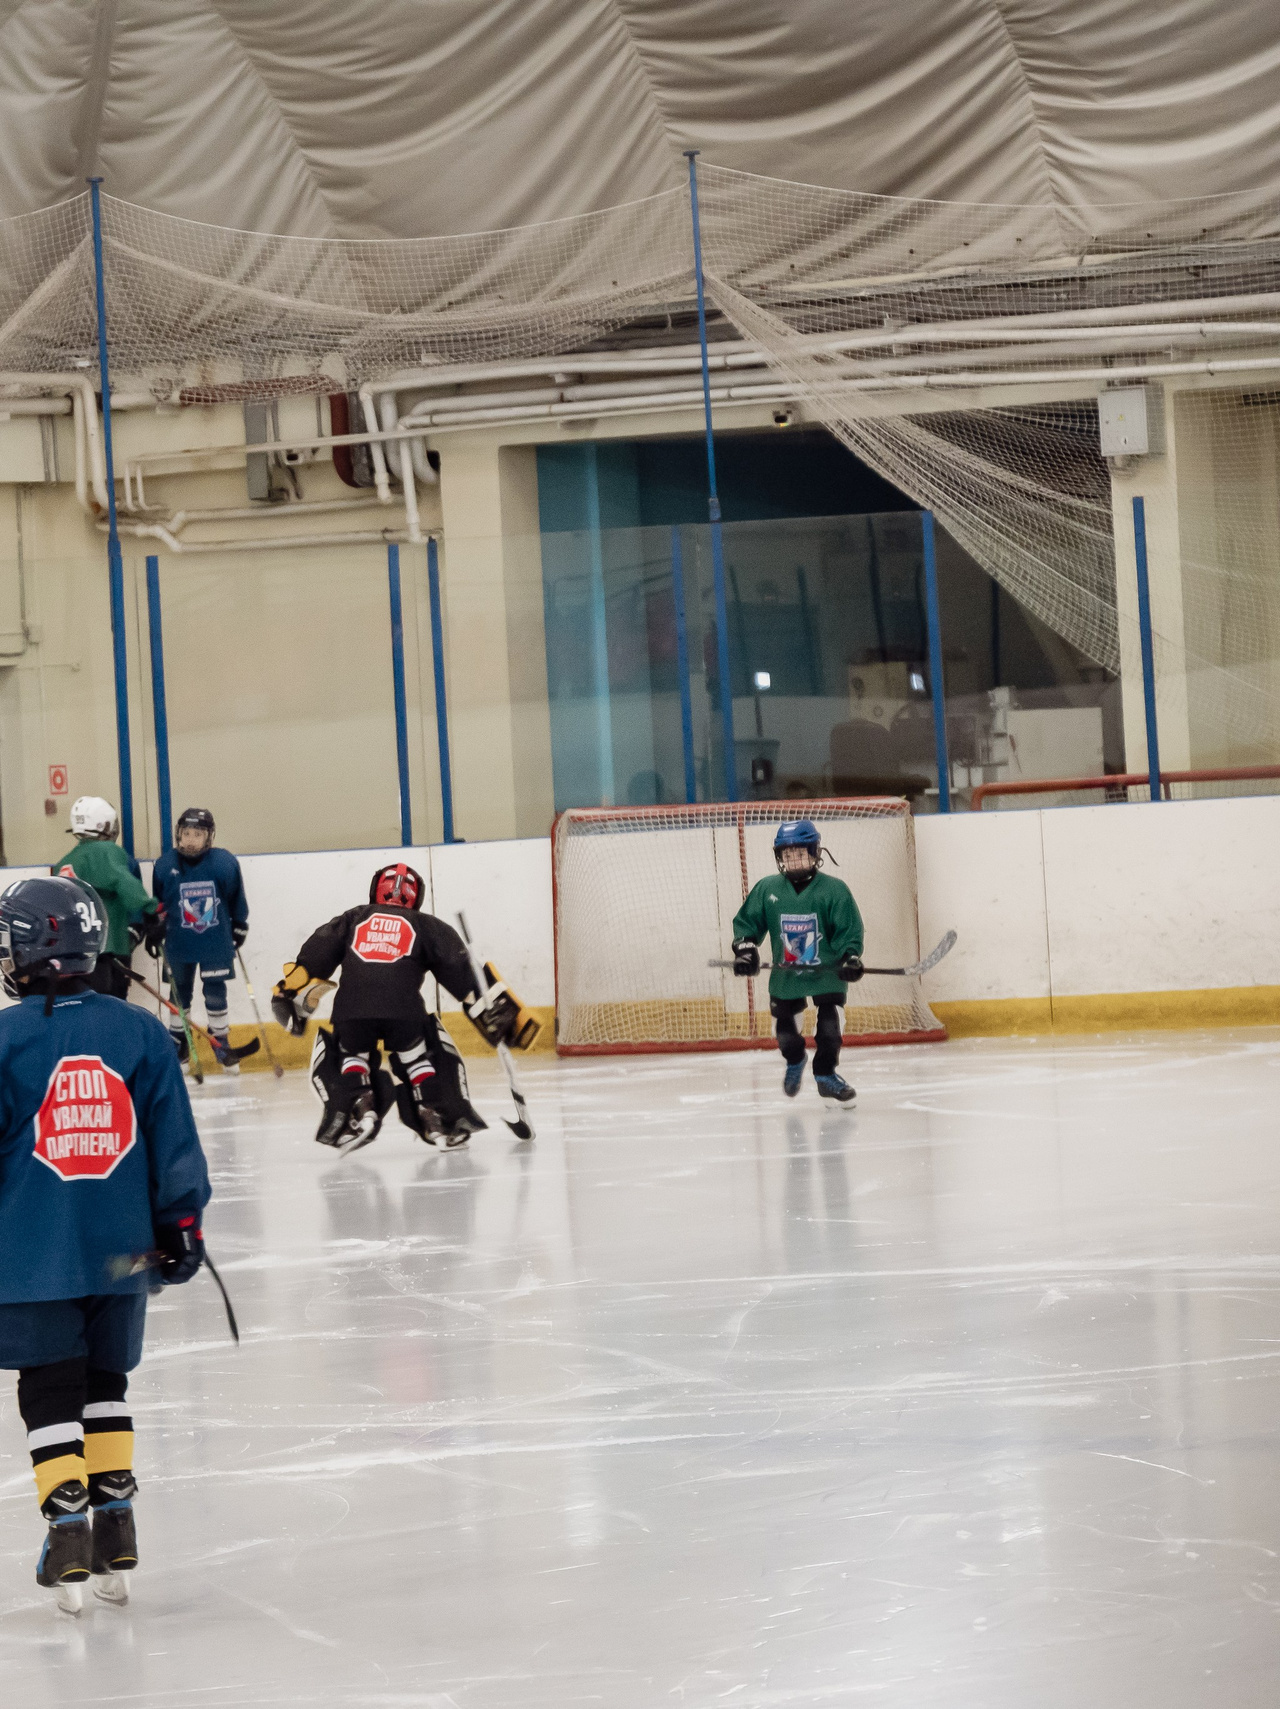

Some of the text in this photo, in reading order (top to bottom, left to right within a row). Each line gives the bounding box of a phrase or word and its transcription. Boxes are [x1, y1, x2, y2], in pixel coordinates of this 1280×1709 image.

[75, 901, 102, 933] 34
[370, 917, 402, 932] СТОП
[56, 1069, 108, 1102] СТОП
[52, 1101, 113, 1131] УВАЖАЙ
[46, 1132, 120, 1161] ПАРТНЕРА!
